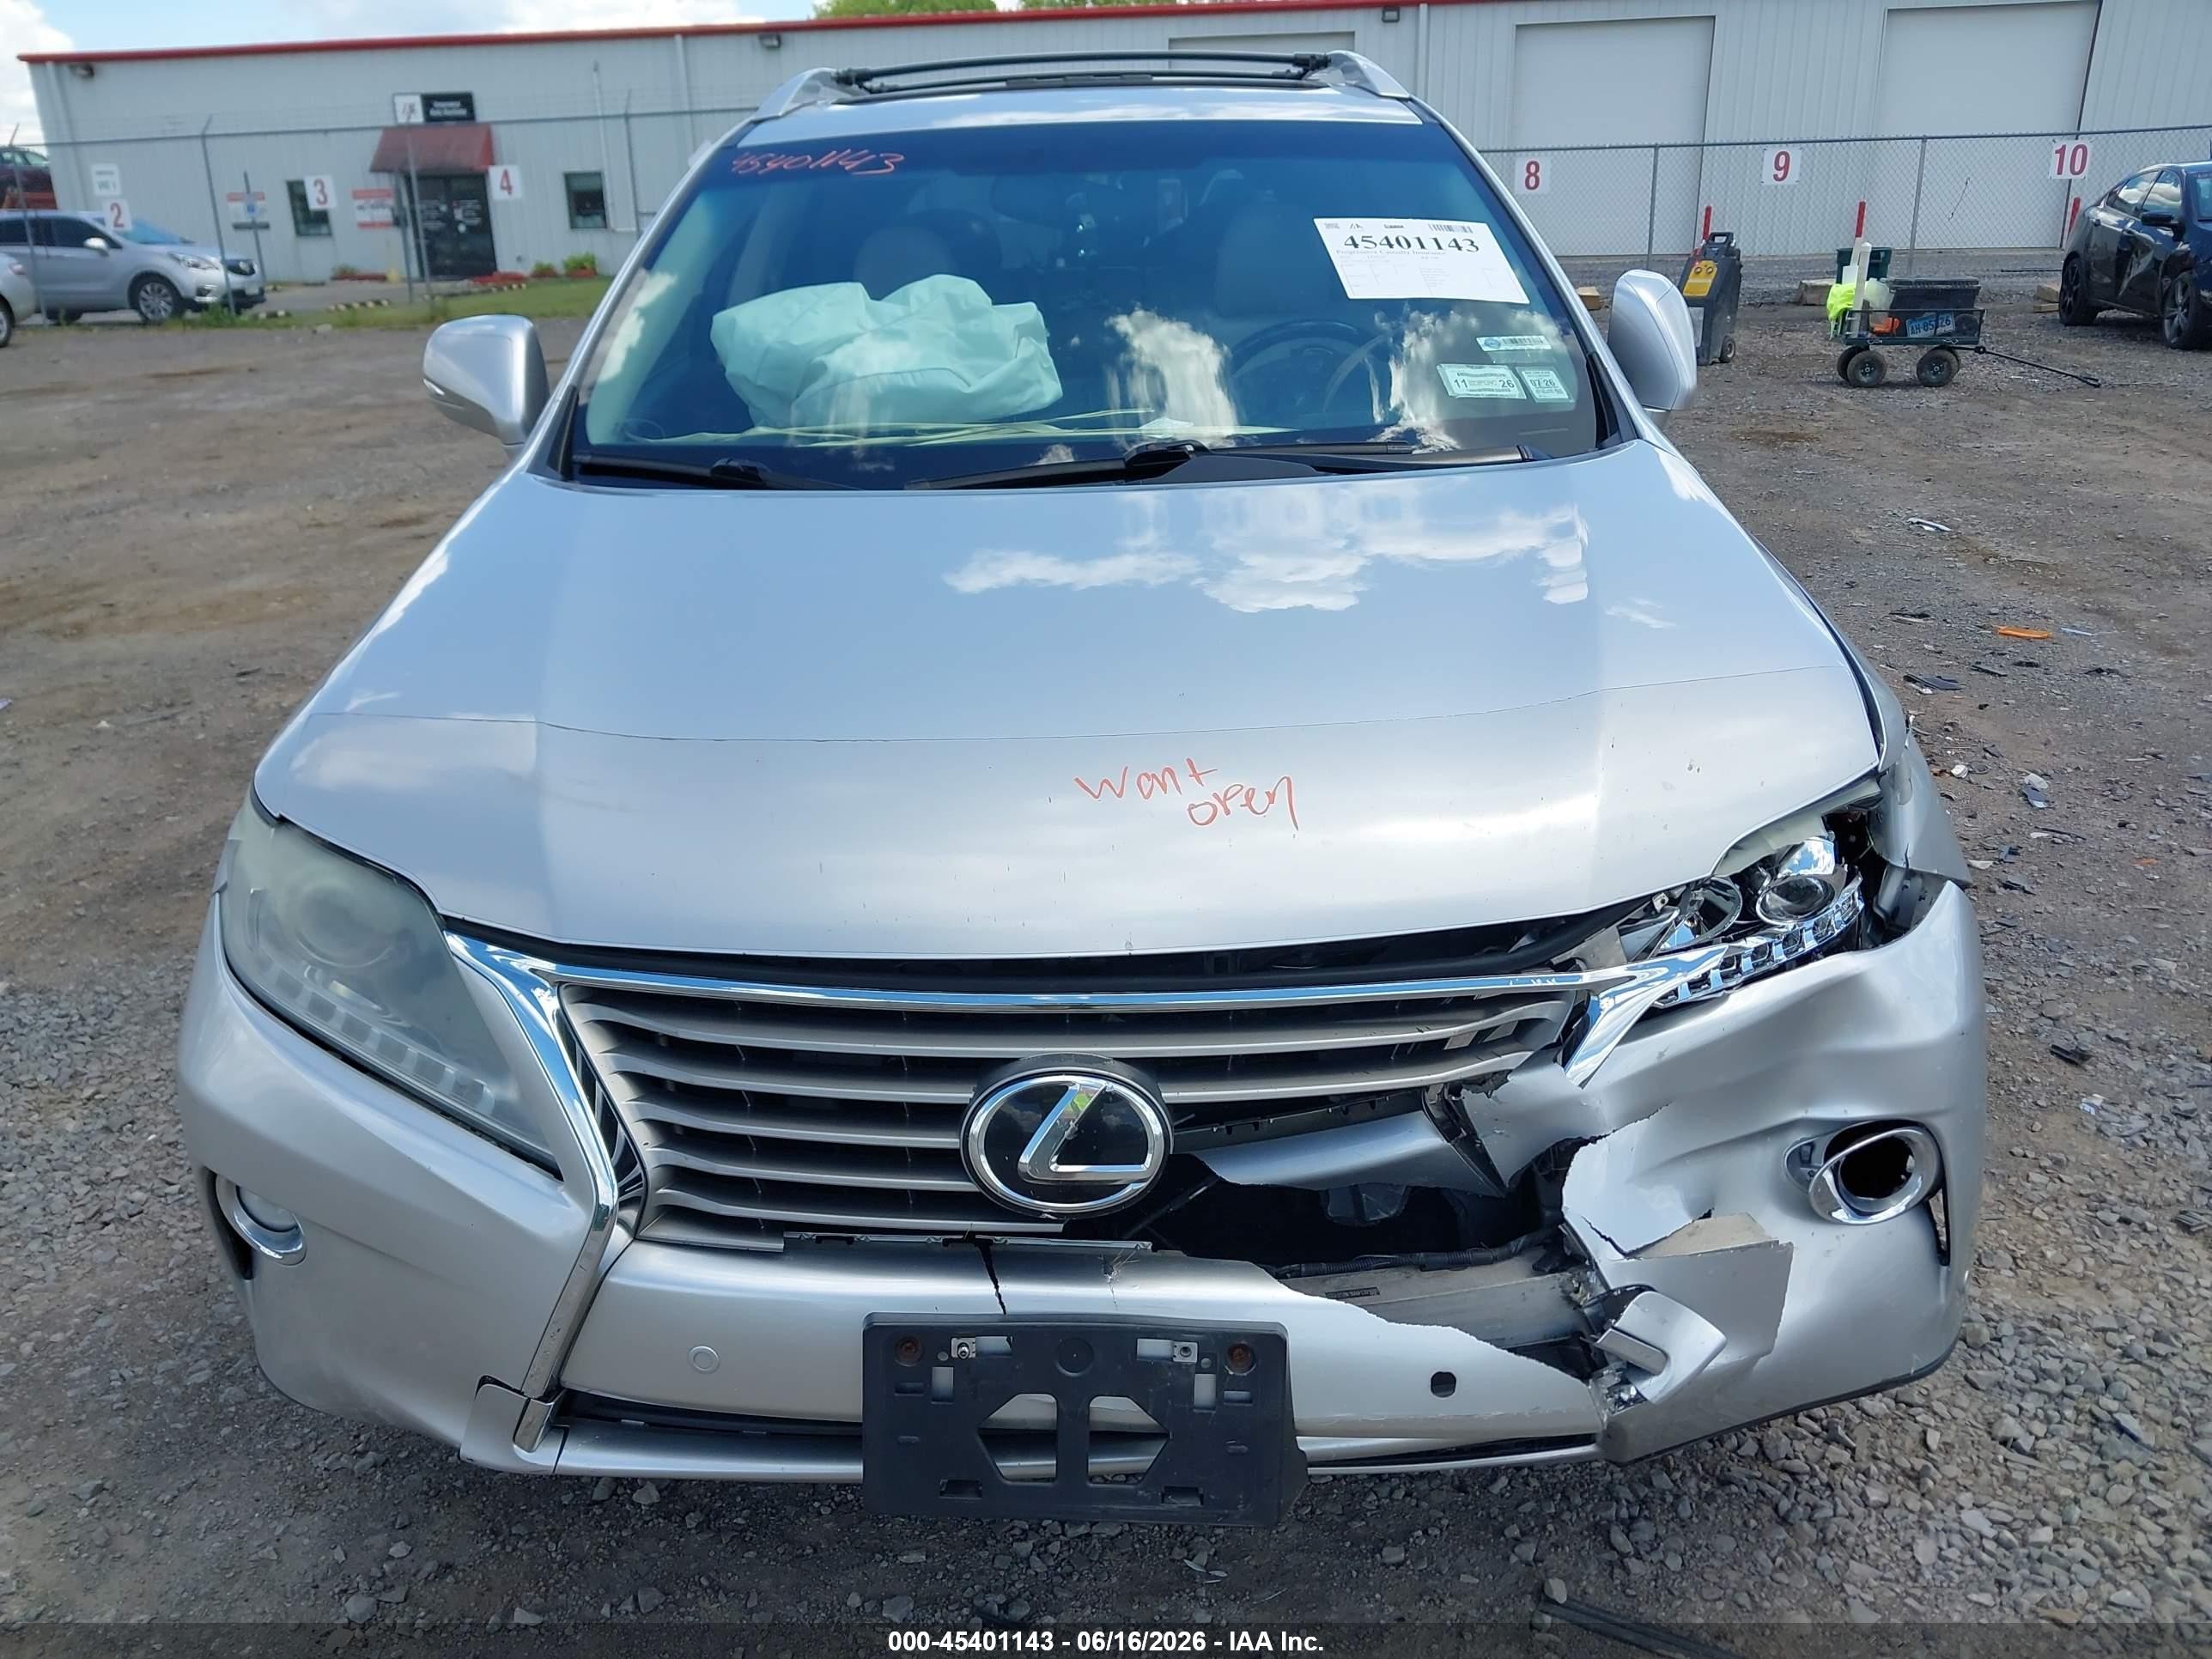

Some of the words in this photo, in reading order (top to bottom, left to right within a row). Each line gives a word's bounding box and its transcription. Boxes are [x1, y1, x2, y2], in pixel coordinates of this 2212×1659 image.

[1772, 150, 1791, 182] 9
[2055, 143, 2087, 175] 10
[500, 168, 513, 196] 4
[1524, 160, 1540, 191] 8
[313, 179, 328, 205] 3
[110, 202, 125, 228] 2
[1344, 234, 1480, 253] 45401143
[1454, 379, 1468, 389] 11
[1498, 379, 1515, 389] 26
[1543, 379, 1556, 387] 26
